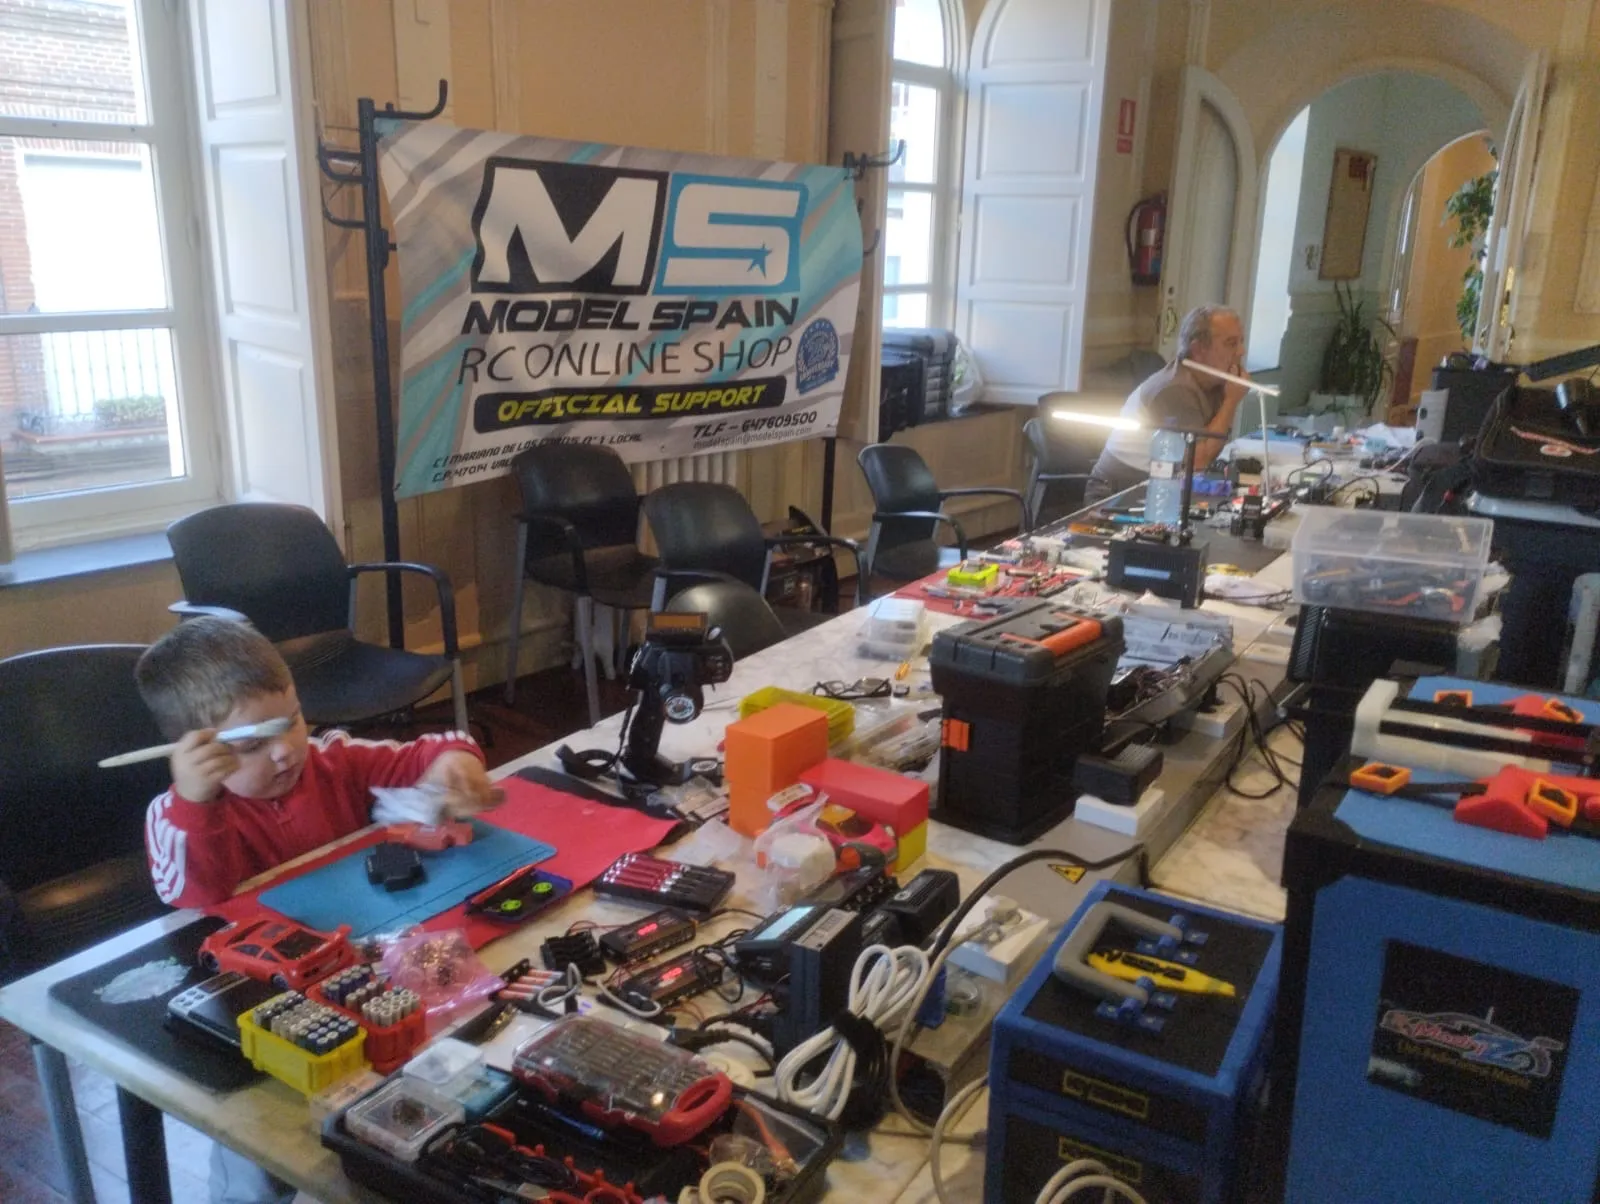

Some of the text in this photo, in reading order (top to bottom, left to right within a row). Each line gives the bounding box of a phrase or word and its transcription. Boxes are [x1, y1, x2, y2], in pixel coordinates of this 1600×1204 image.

[461, 297, 799, 335] MODEL SPAIN
[458, 345, 517, 385] RC
[524, 341, 681, 378] ONLINE
[693, 335, 793, 373] SHOP
[497, 384, 768, 423] OFFICIAL SUPPORT
[692, 421, 729, 439] TLF
